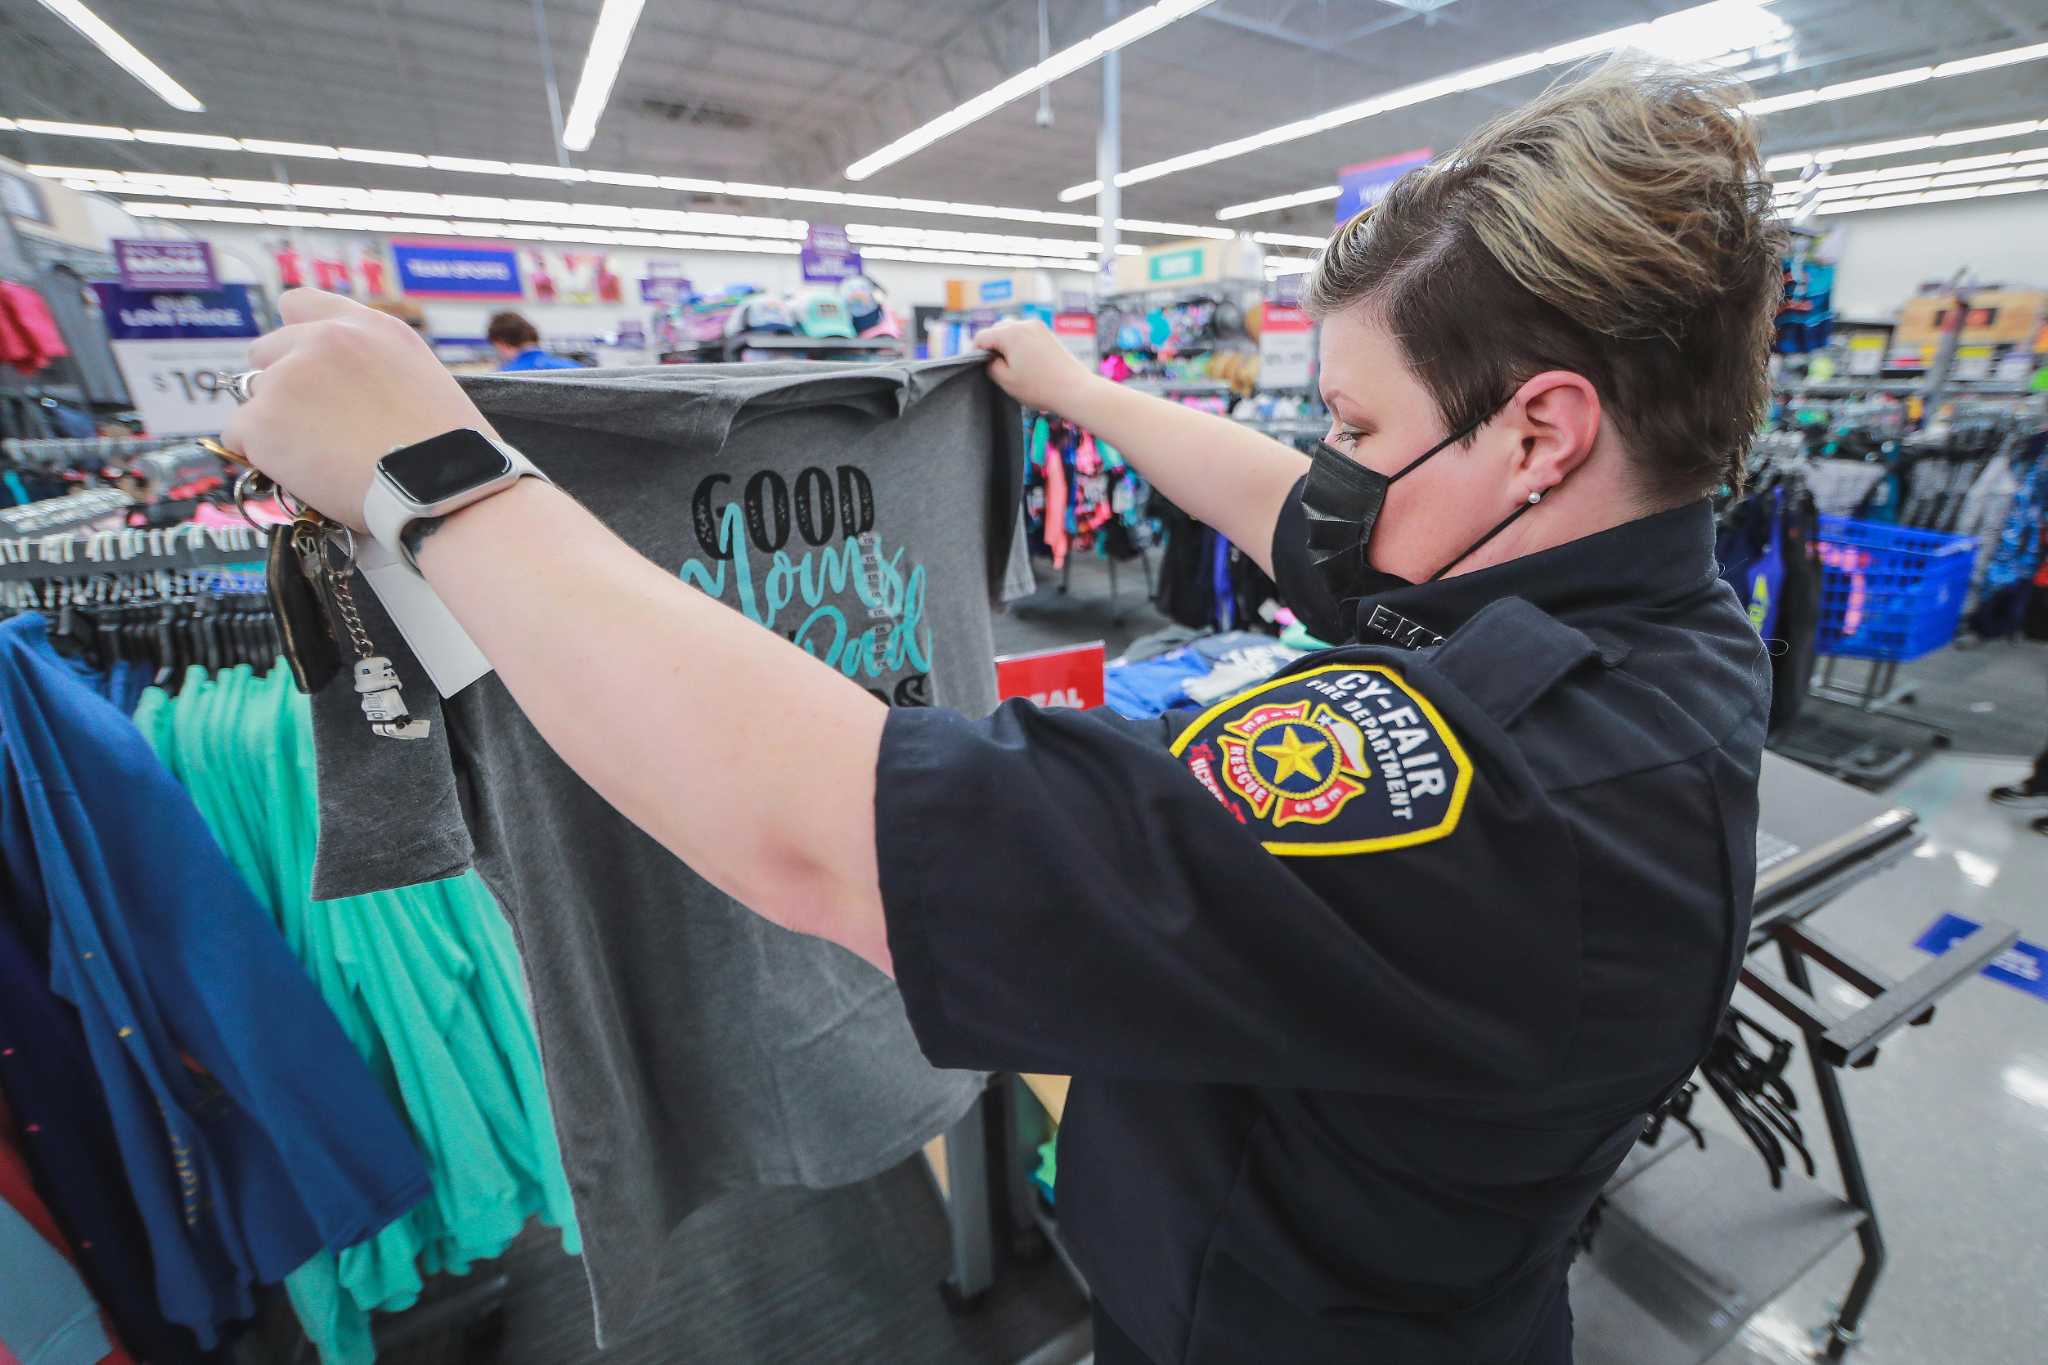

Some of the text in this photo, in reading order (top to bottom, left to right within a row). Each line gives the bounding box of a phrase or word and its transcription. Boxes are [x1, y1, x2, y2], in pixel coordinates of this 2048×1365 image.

[176, 308, 244, 327] PRICE
[692, 465, 875, 561] GOOD
[1028, 687, 1085, 708] EAL
[1241, 709, 1300, 732] FIRE
[1334, 671, 1447, 799] CY-FAIR
[1305, 679, 1414, 820] FIRE DEPARTMENT
[1229, 745, 1268, 803] RESCUE
[1294, 786, 1343, 814] EMS
